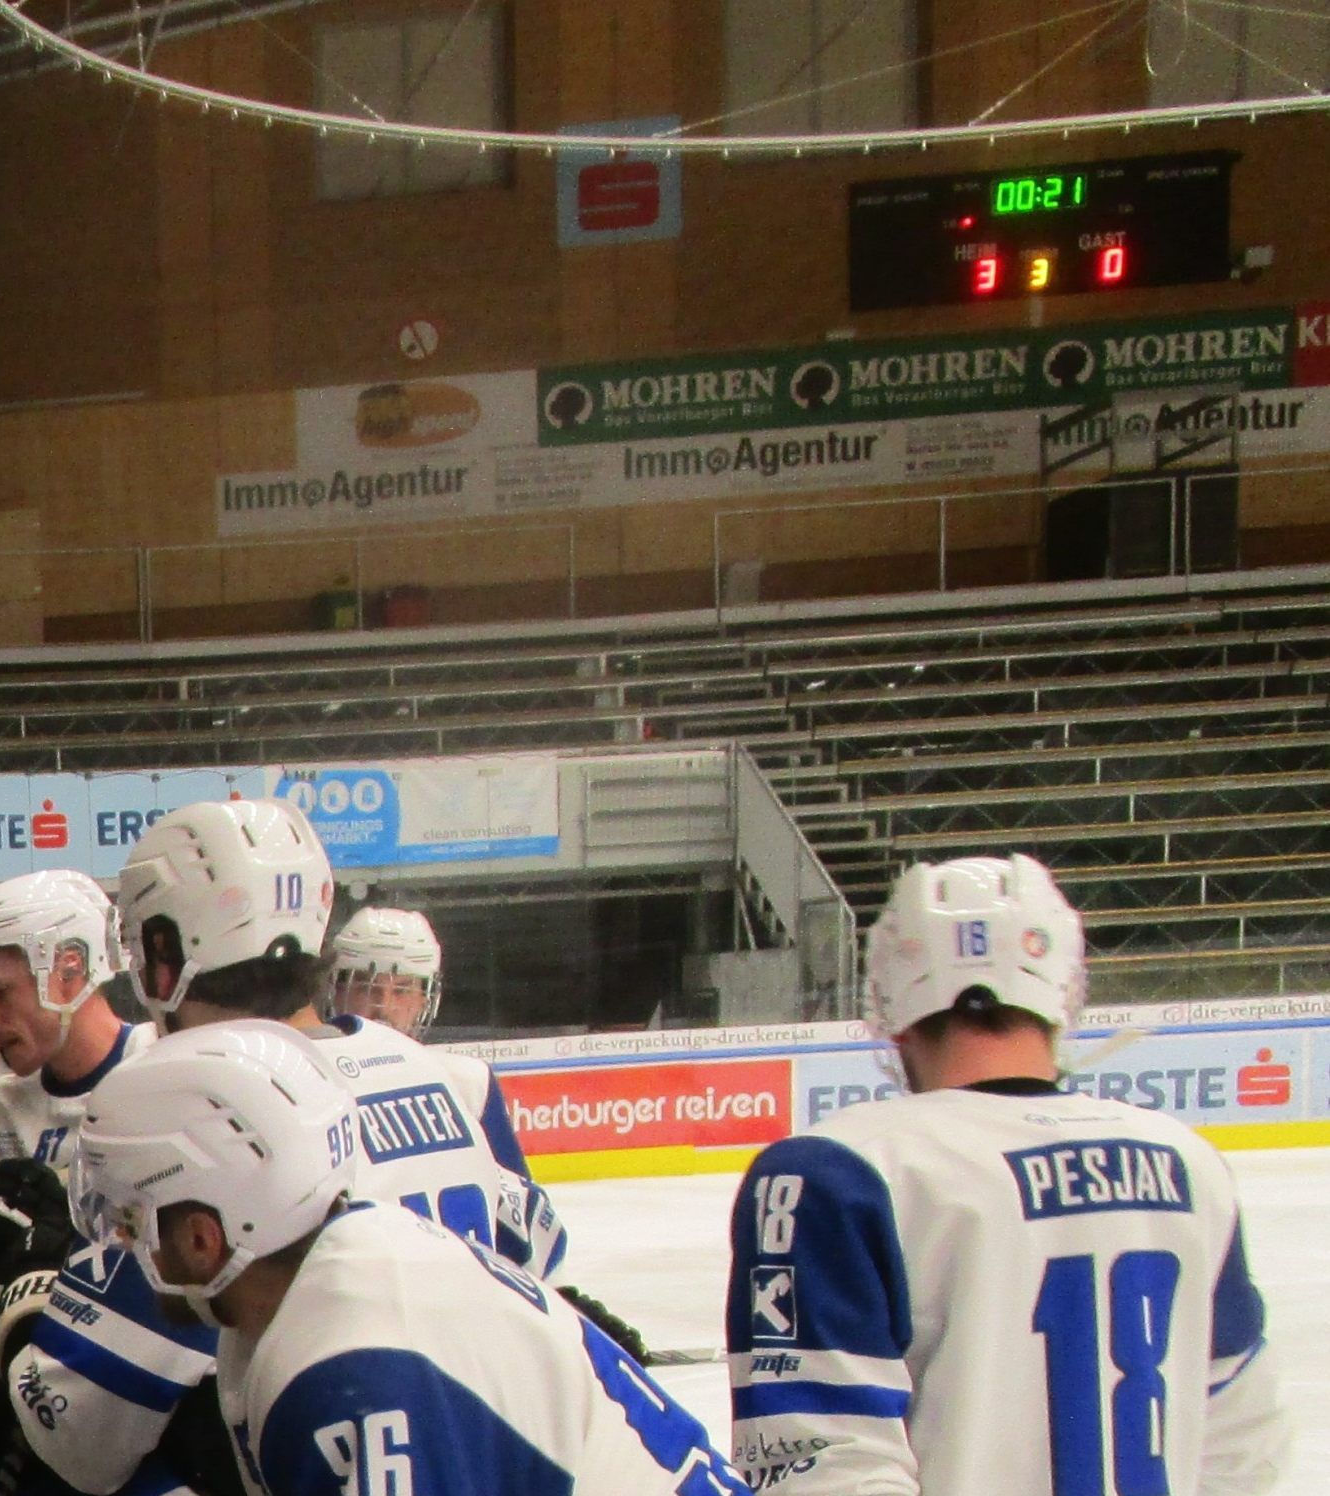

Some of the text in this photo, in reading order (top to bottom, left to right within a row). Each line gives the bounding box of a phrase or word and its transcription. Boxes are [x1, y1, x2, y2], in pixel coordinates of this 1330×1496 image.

[996, 176, 1085, 214] 00:21
[1079, 231, 1127, 251] GAST
[974, 247, 1126, 291] 3 3 0
[850, 346, 1029, 390] MOHREN
[1105, 324, 1289, 370] MOHREN
[602, 366, 778, 411] MOHREN
[274, 872, 304, 911] 10
[955, 920, 991, 957] 18
[357, 1088, 461, 1154] RITTER
[513, 1086, 776, 1134] herburger reisen
[326, 1112, 355, 1170] 96
[1026, 1146, 1181, 1209] PESJAK
[755, 1174, 804, 1255] 18
